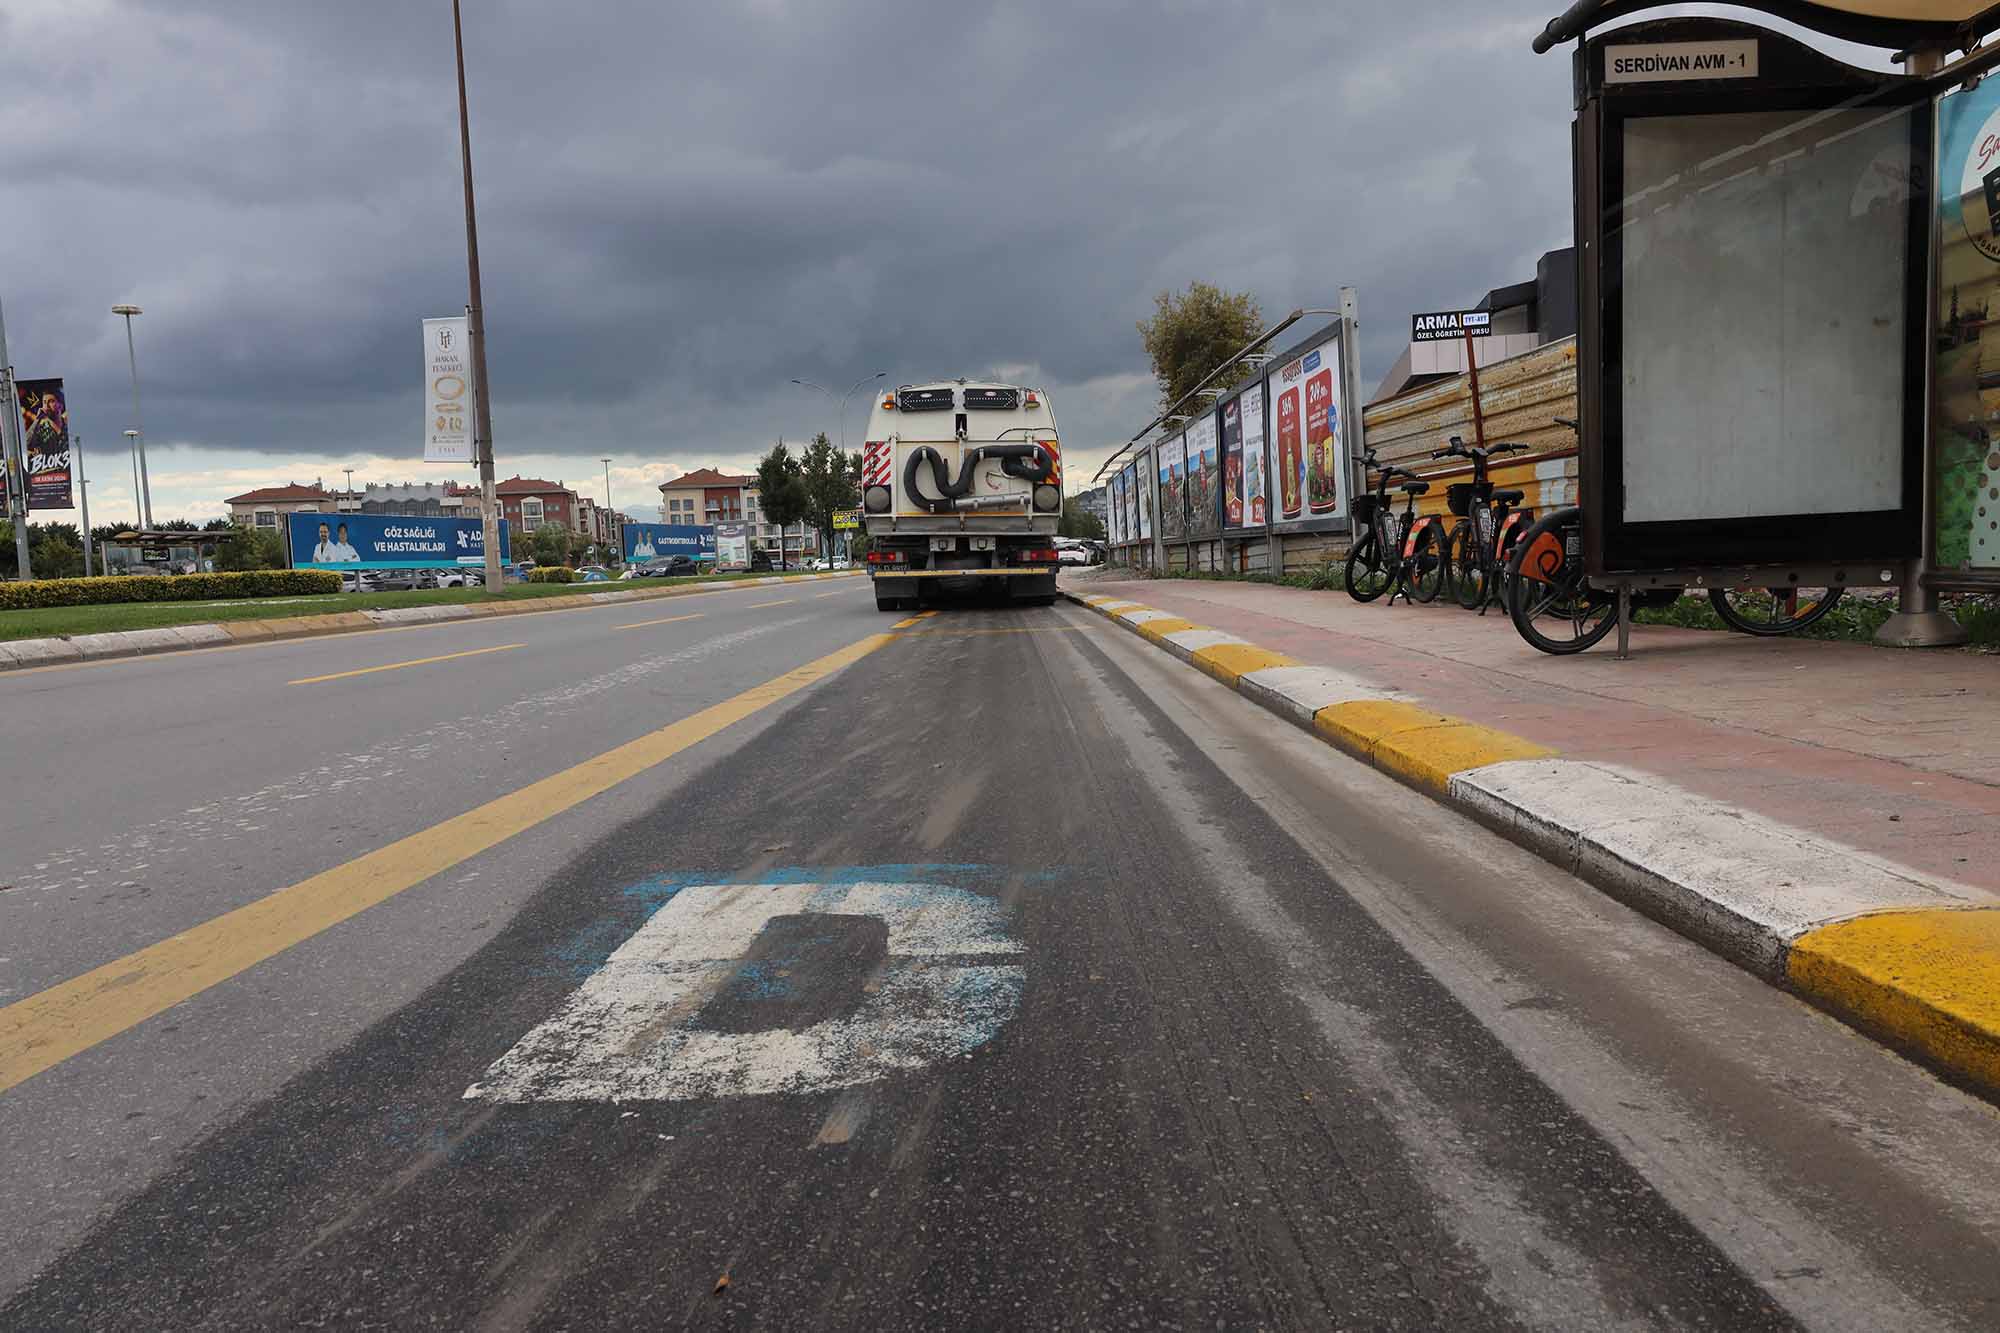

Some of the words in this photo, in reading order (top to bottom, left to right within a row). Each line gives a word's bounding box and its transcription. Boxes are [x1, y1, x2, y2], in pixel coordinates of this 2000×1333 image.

[1614, 54, 1689, 73] SERDİVAN
[1693, 54, 1725, 69] AVM
[1738, 53, 1745, 68] 1
[1415, 315, 1458, 330] ARMA
[1417, 331, 1434, 340] ÖZEL
[30, 450, 71, 474] BLOK3
[384, 526, 402, 538] GÖZ
[404, 526, 436, 538] SAĞLIĞI
[374, 542, 387, 552] VE
[387, 542, 446, 552] HASTALIKLARI
